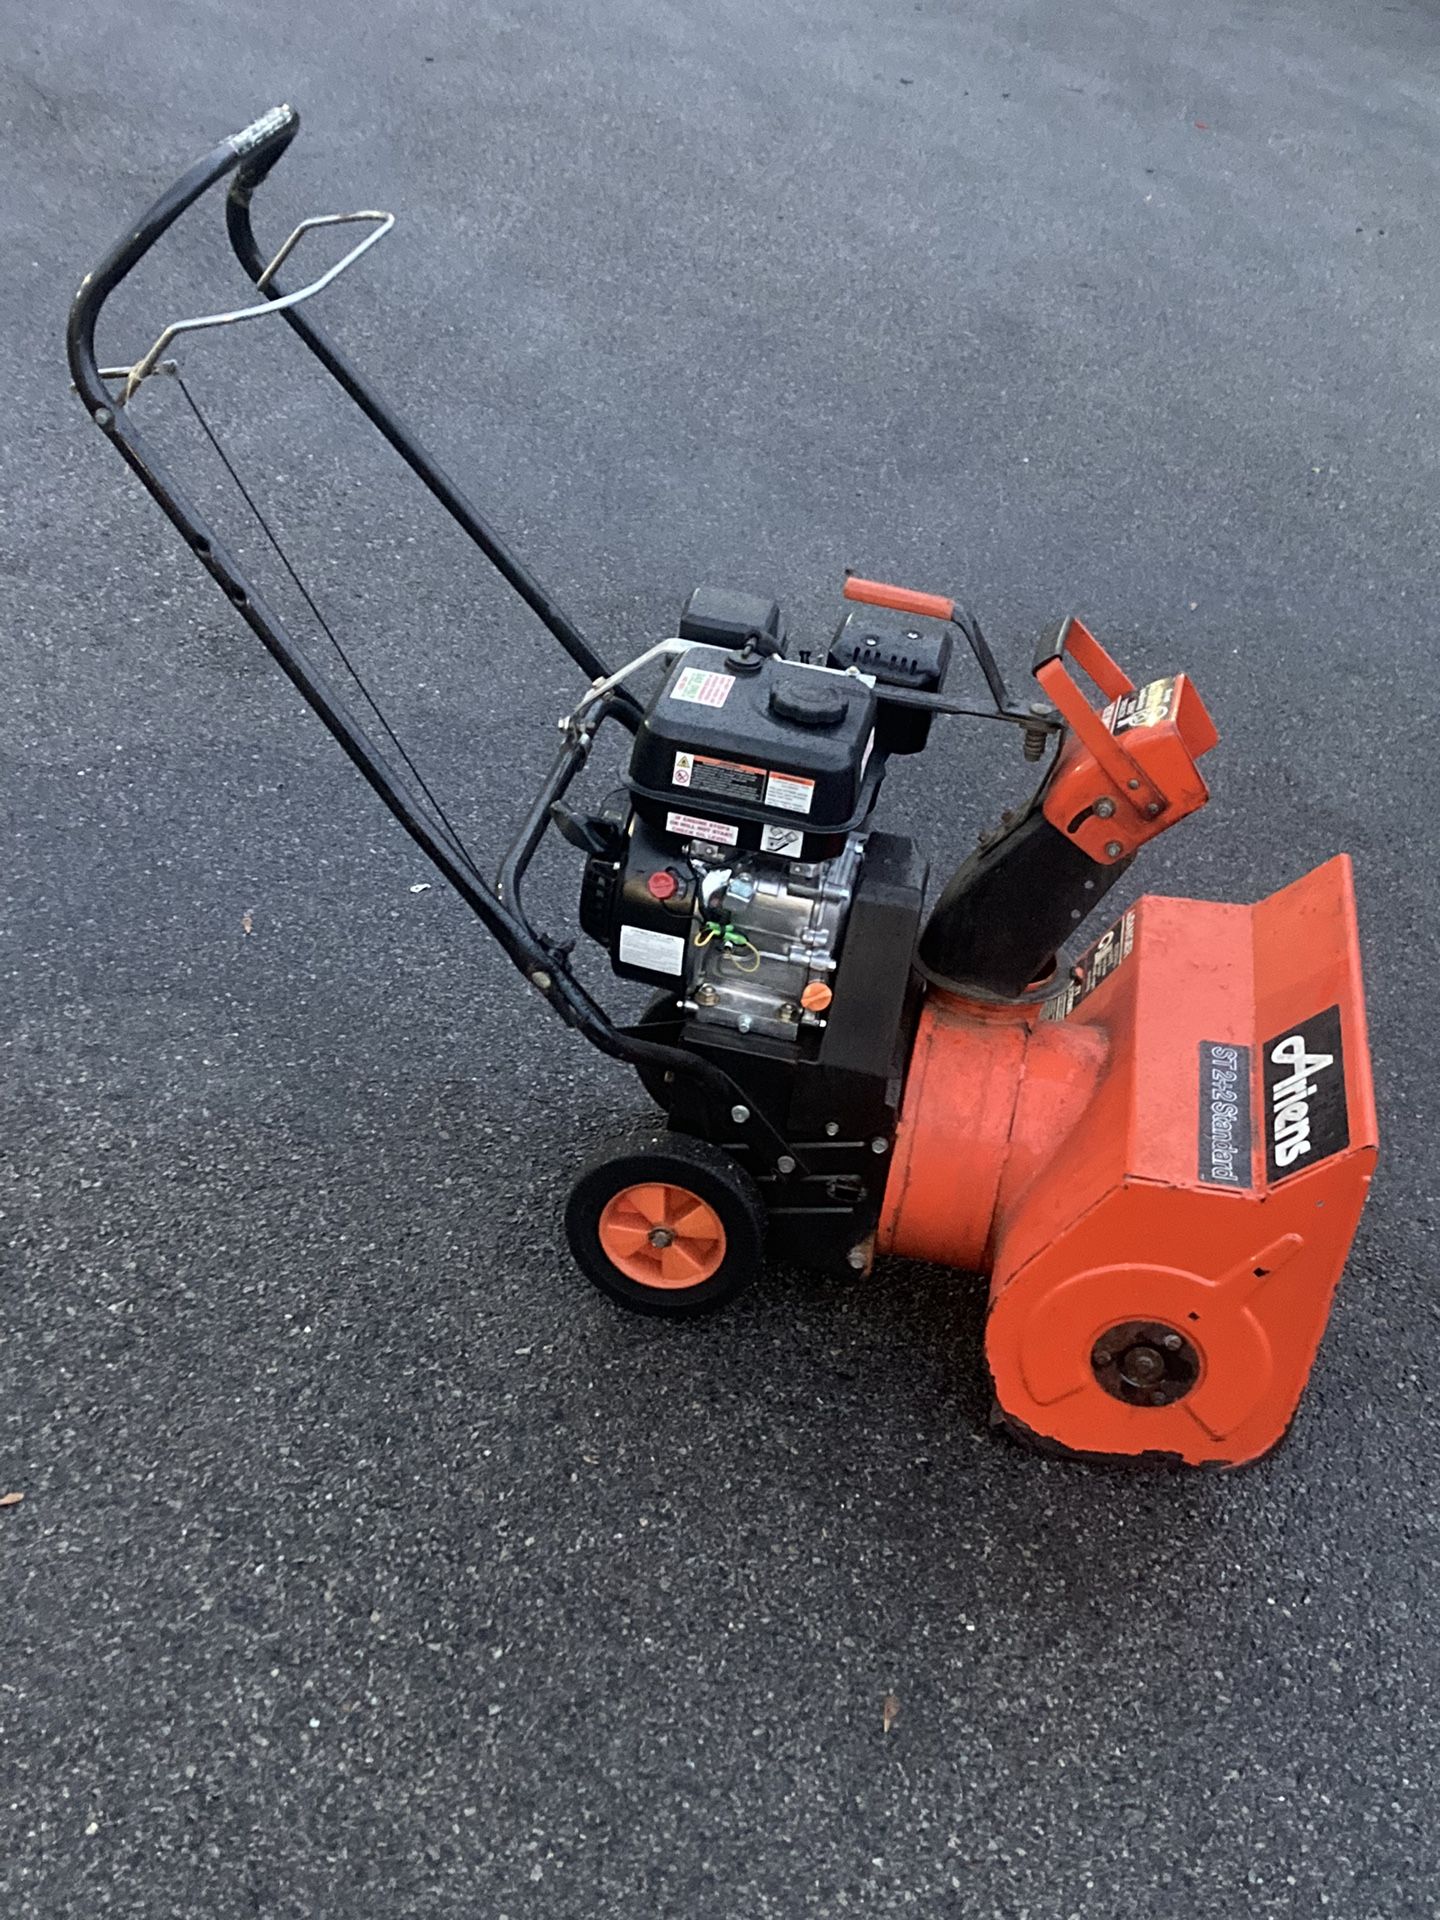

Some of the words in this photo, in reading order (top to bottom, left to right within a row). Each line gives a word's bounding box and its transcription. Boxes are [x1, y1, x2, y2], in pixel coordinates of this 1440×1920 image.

[1211, 1046, 1238, 1071] ST
[1211, 1069, 1238, 1100] 2+2
[1271, 1035, 1334, 1167] Ariens
[1211, 1101, 1239, 1181] Standard
